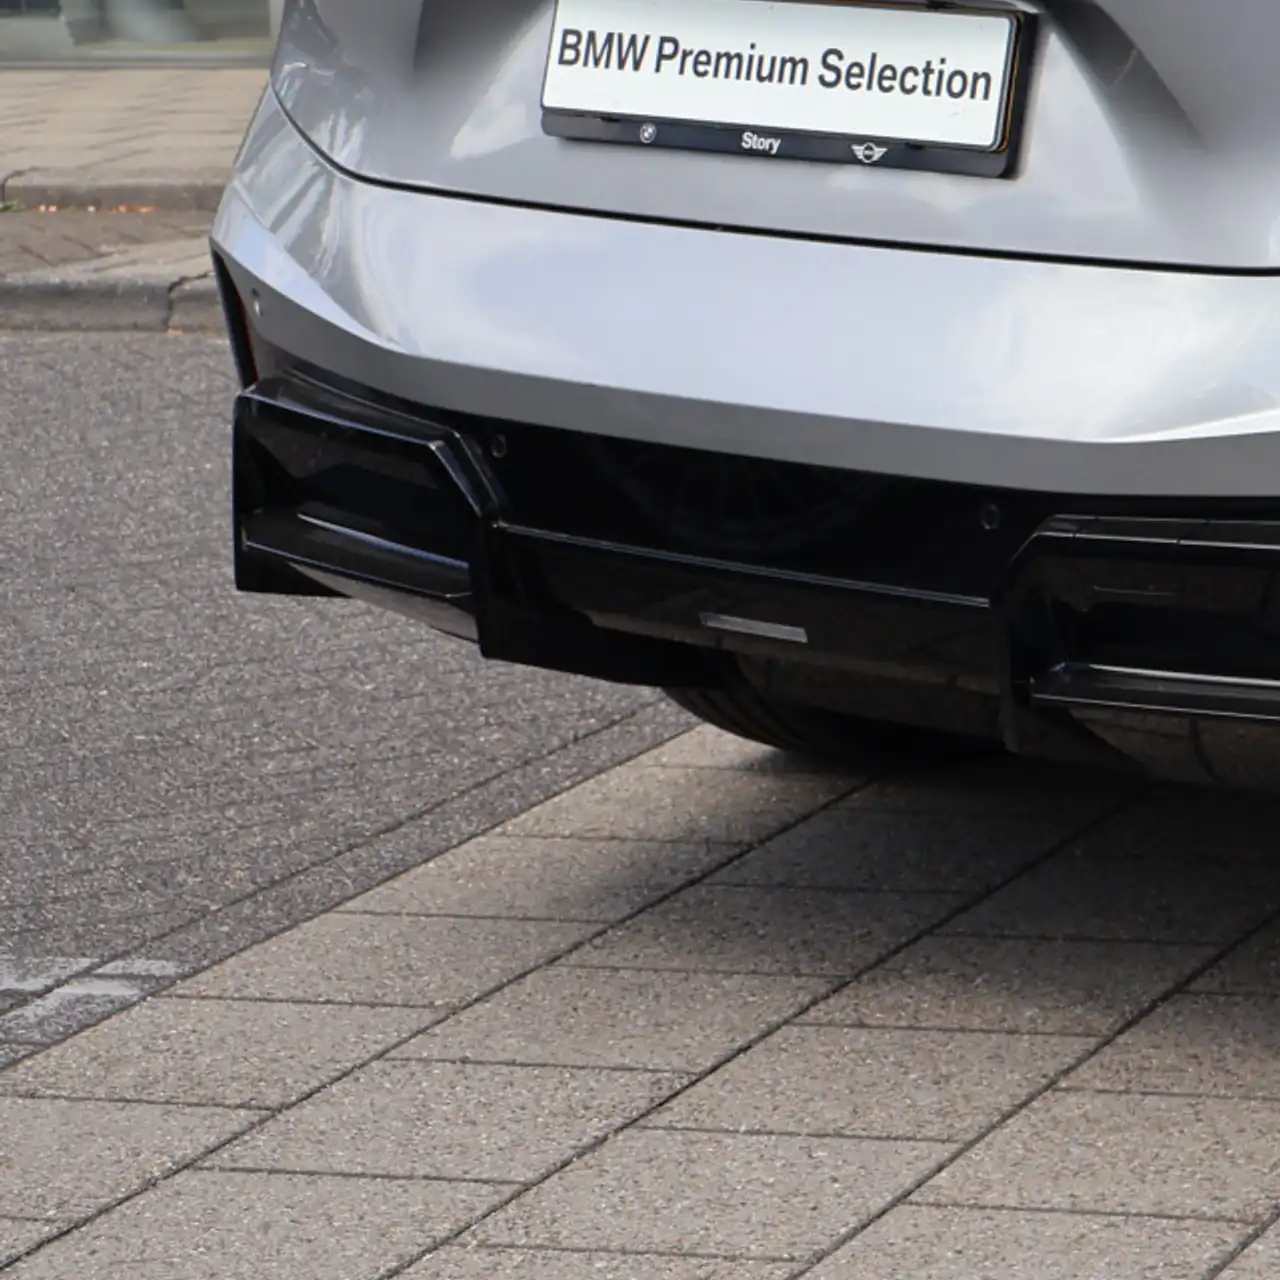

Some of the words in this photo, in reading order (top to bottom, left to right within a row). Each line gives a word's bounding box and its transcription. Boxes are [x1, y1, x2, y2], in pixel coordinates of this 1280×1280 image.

[558, 28, 651, 73] BMW
[654, 34, 810, 87] Premium
[817, 46, 992, 102] Selection
[741, 131, 781, 155] Story
